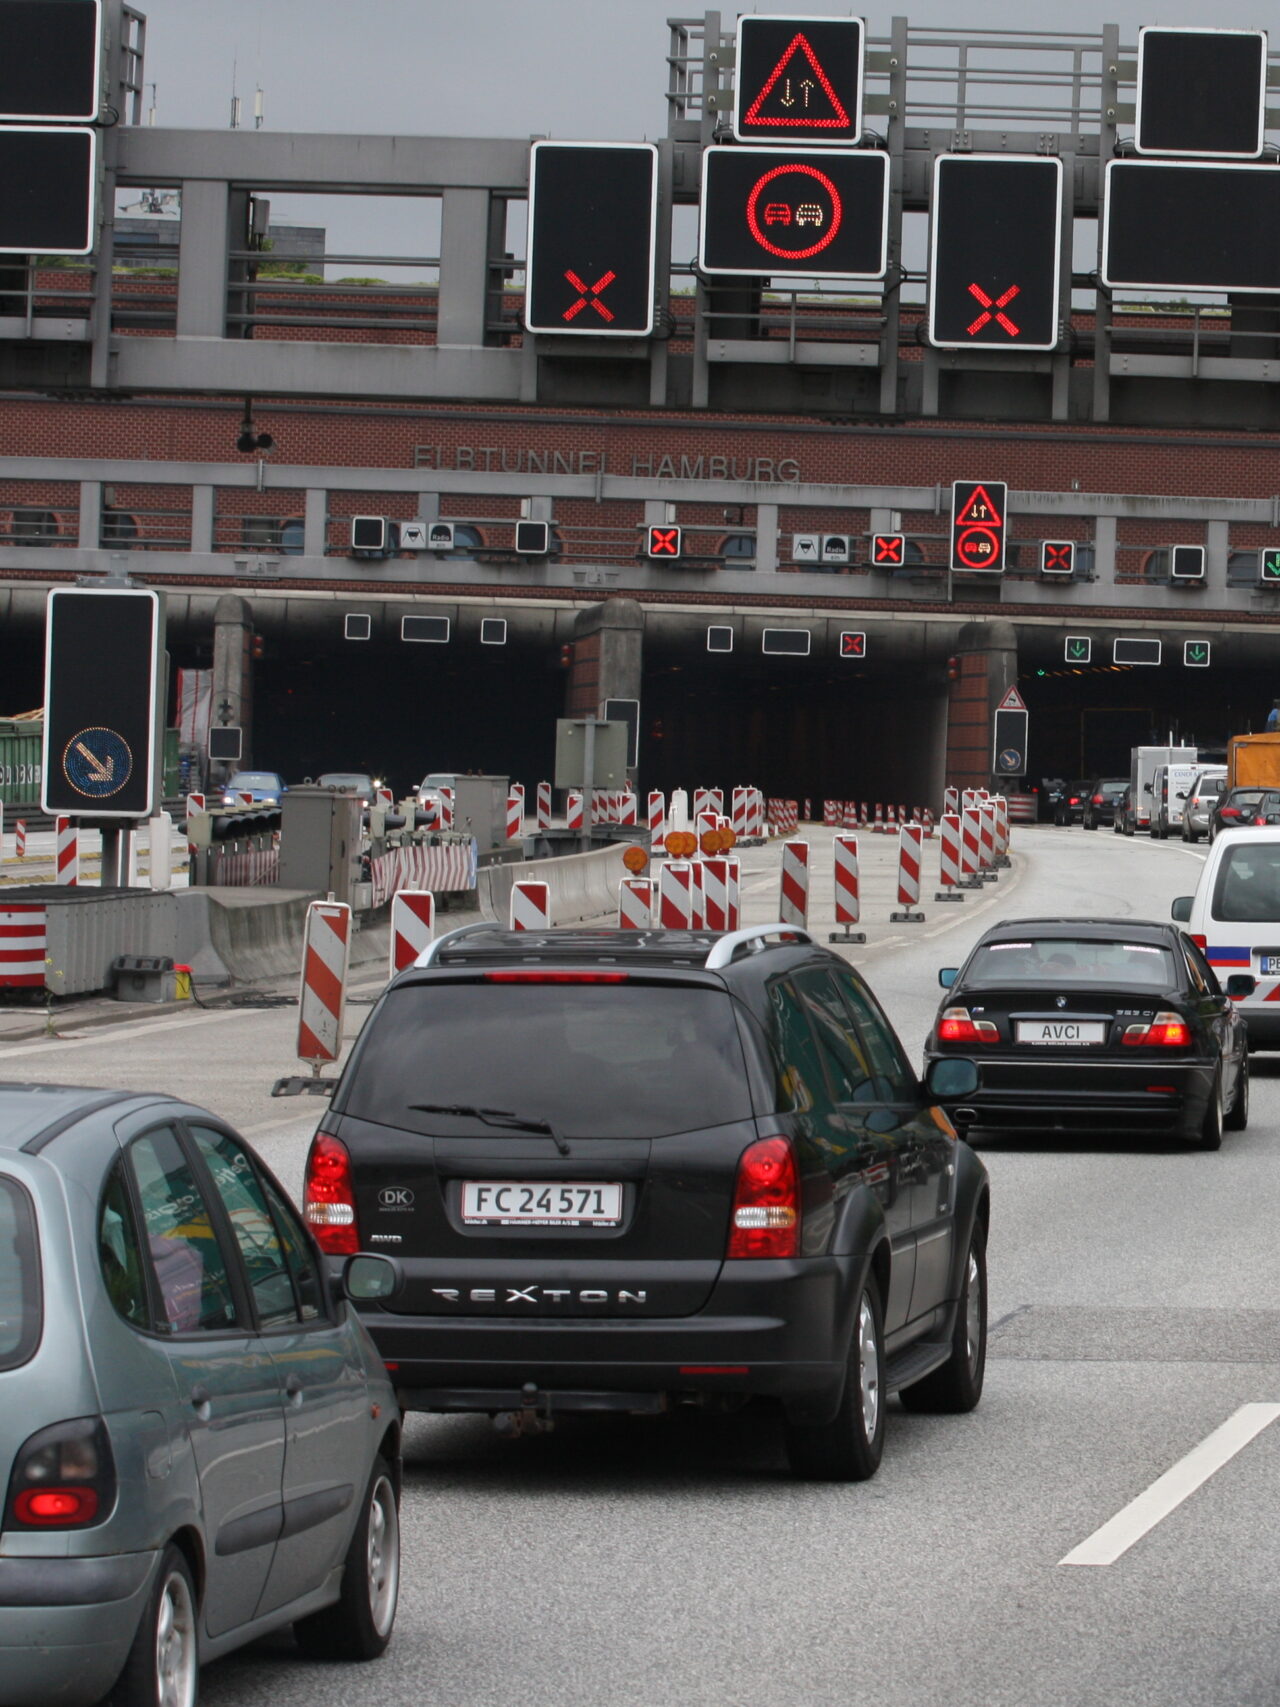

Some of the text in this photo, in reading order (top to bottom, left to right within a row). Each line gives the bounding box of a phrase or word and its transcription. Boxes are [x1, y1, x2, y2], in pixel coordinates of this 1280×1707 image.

[414, 446, 800, 483] ELBTUNNEL HAMBURG
[1041, 1025, 1080, 1039] AVCI
[384, 1190, 408, 1204] DK
[477, 1188, 512, 1212] FC
[431, 1285, 646, 1303] REXTON
